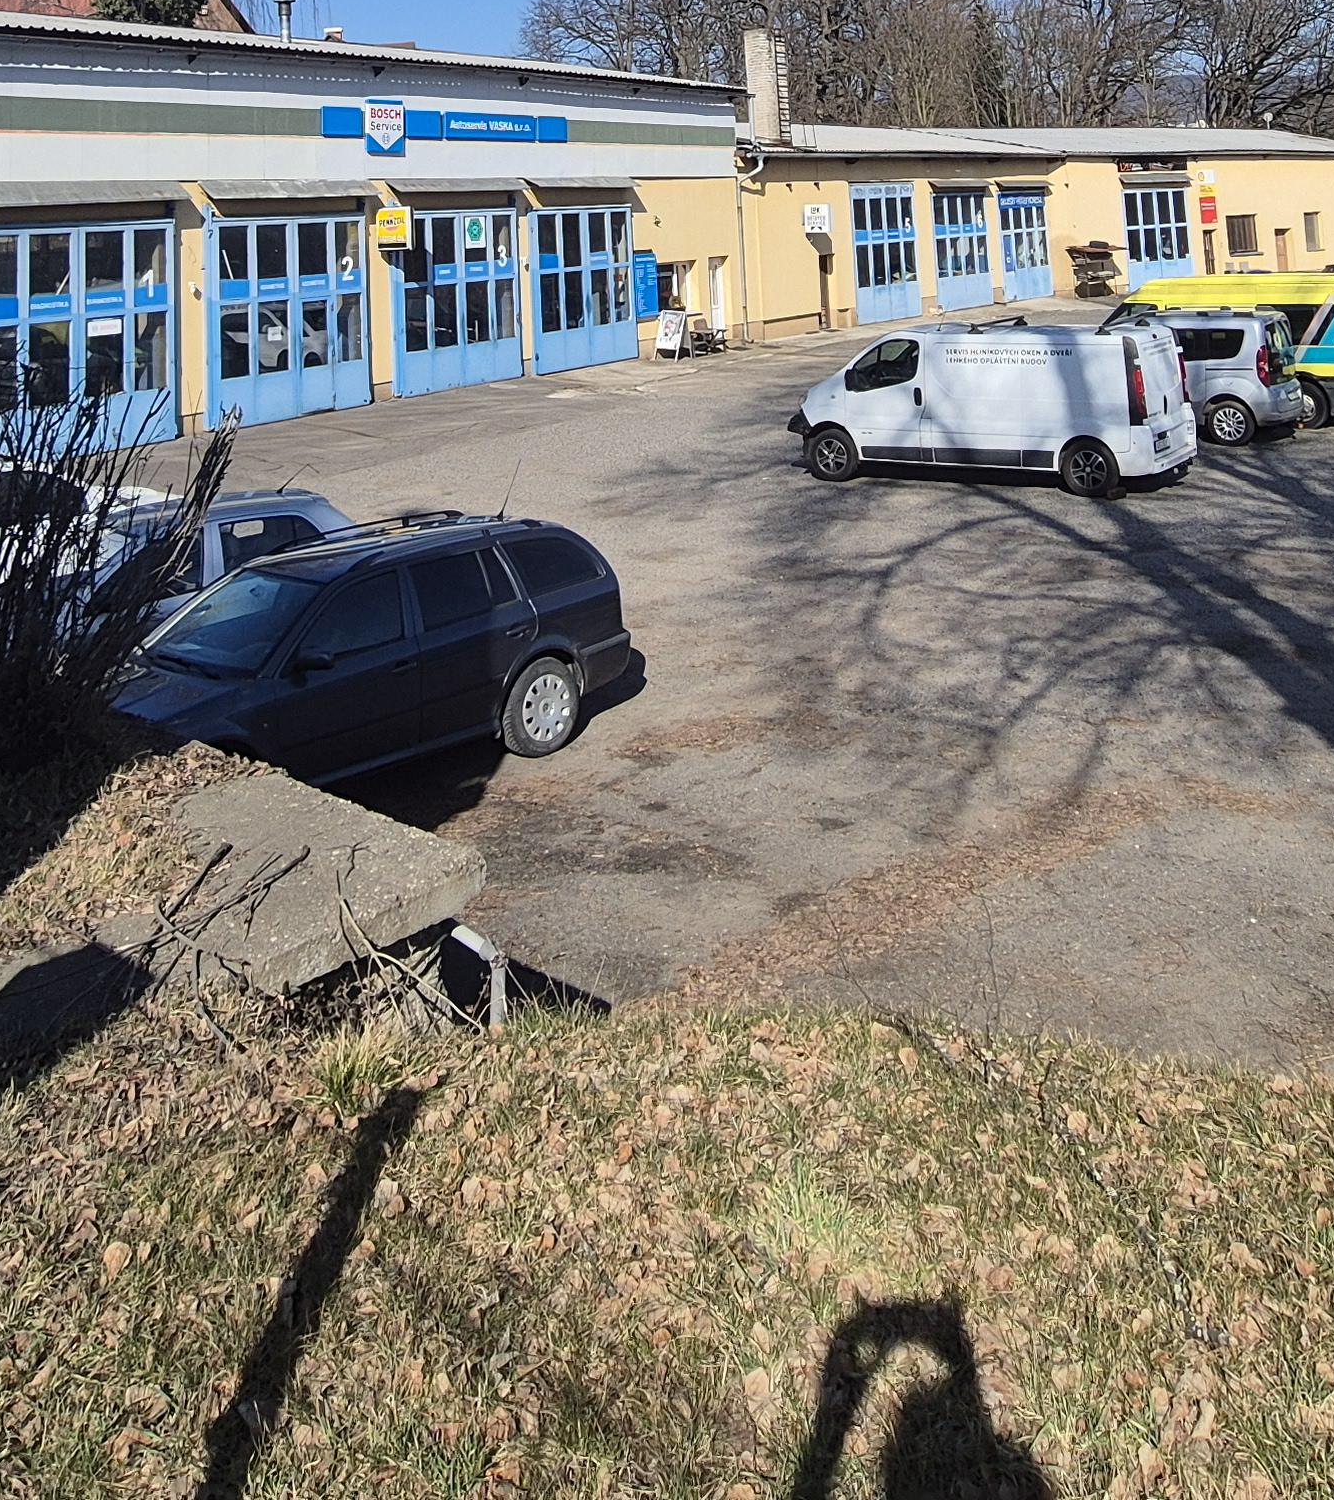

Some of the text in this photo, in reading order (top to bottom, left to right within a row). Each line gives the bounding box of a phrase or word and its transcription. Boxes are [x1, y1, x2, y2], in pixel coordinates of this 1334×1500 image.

[370, 108, 401, 119] BOSCH
[370, 121, 402, 131] Service
[497, 245, 507, 267] 3
[341, 256, 354, 281] 2
[140, 269, 154, 298] 1
